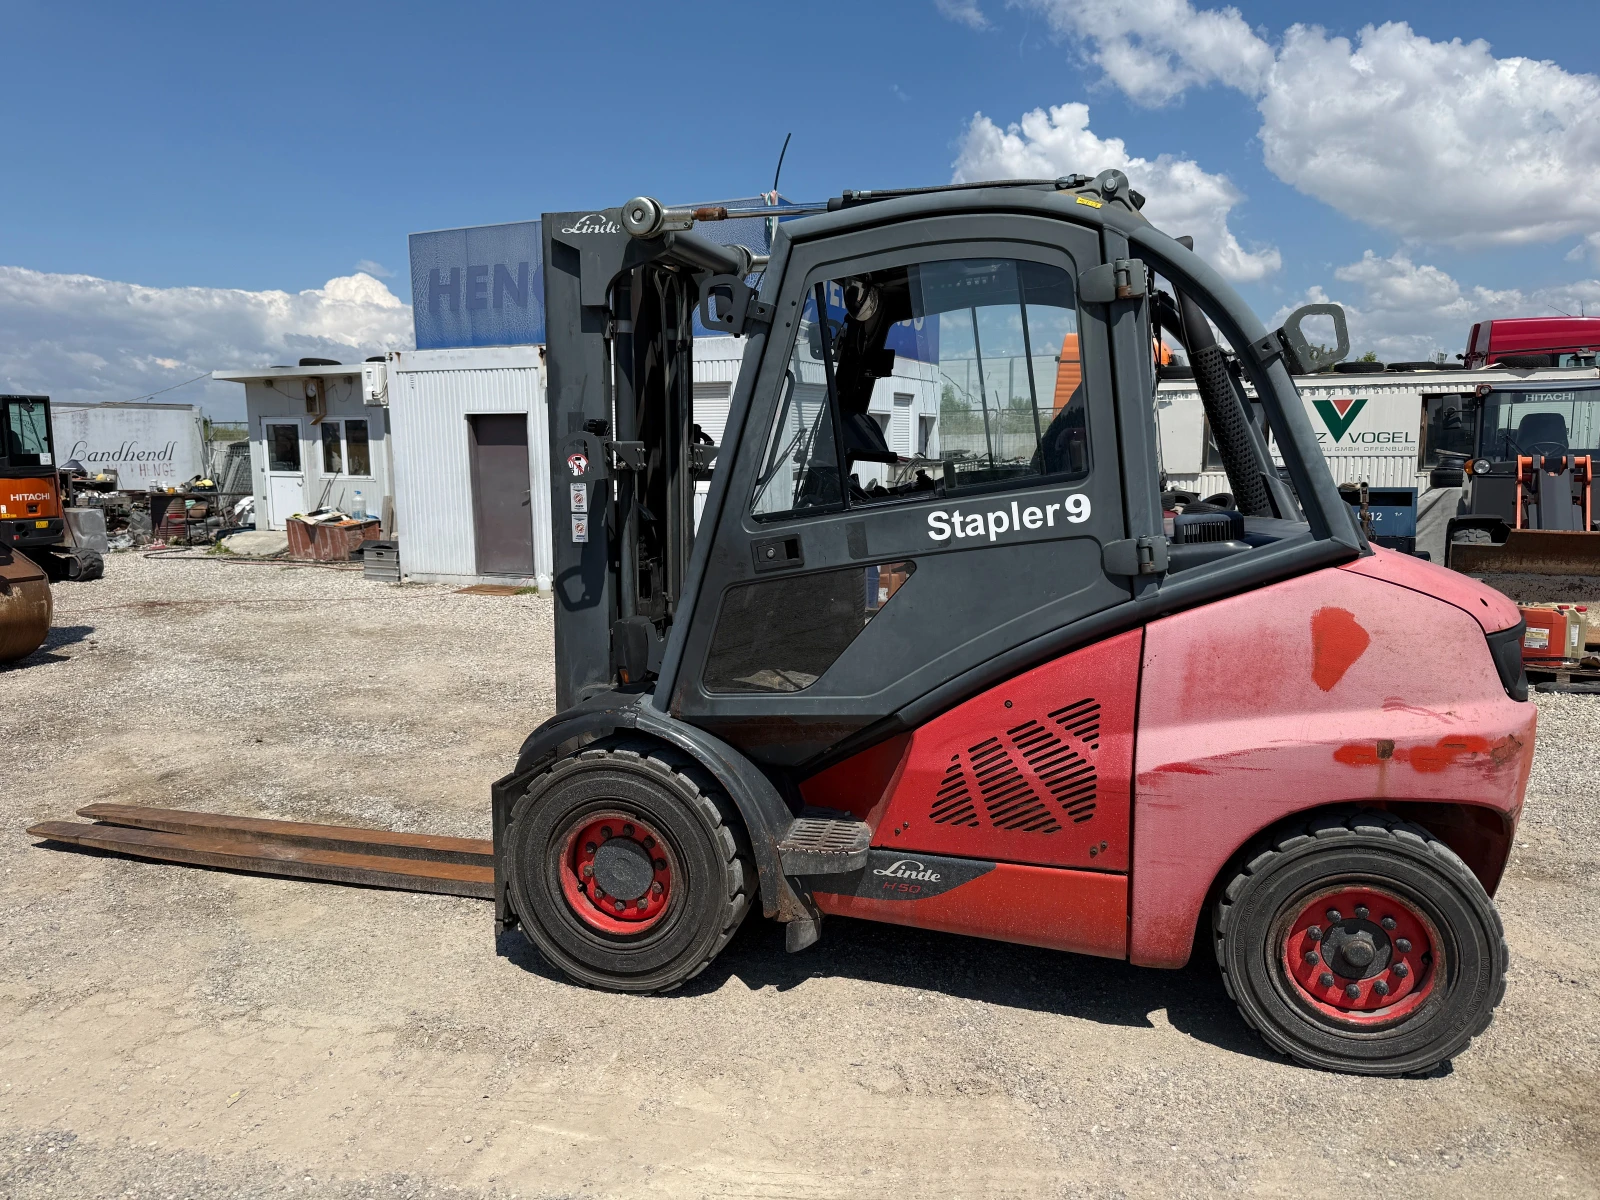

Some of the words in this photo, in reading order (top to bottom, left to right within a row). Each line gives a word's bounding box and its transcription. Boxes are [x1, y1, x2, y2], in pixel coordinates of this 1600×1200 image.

[561, 213, 621, 234] Linde
[1525, 392, 1575, 402] HITACHI
[1348, 431, 1416, 444] VOGEL
[68, 440, 178, 462] Landhendl
[10, 493, 51, 502] HITACHI
[927, 501, 1061, 542] Stapler
[1064, 493, 1092, 524] 9
[872, 859, 941, 883] Linde
[1443, 956, 1491, 1041] MARANGONI
